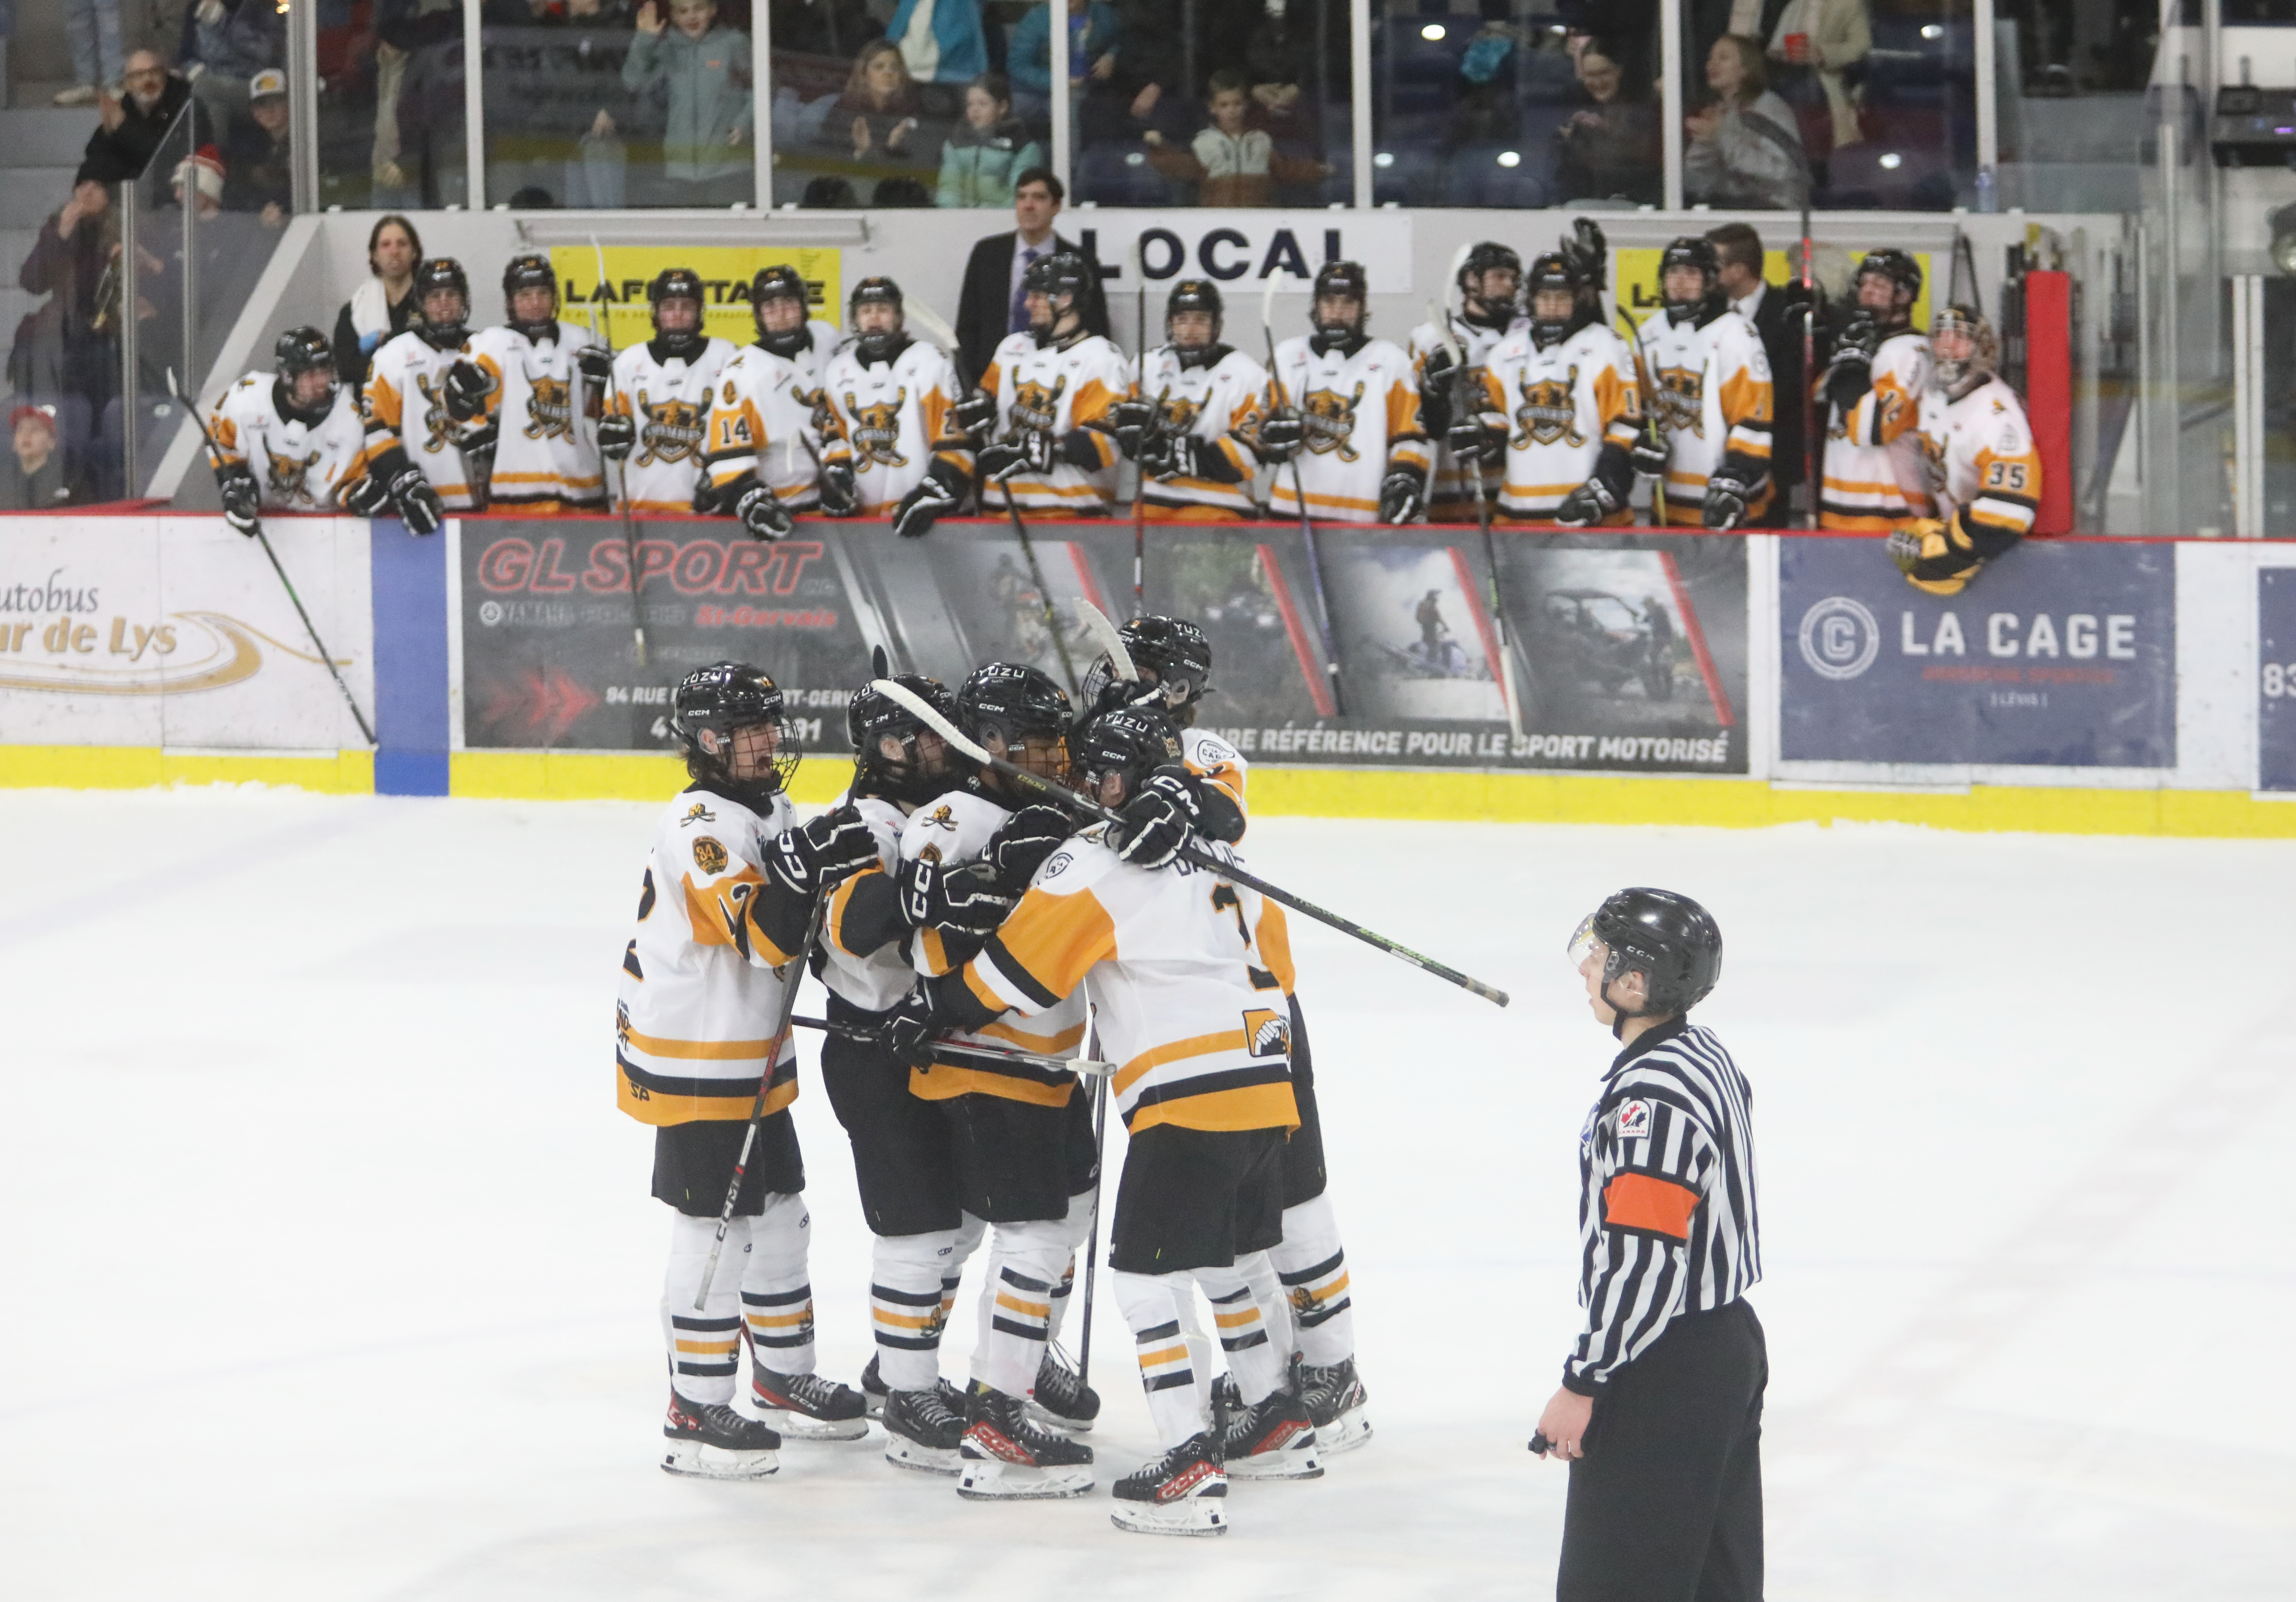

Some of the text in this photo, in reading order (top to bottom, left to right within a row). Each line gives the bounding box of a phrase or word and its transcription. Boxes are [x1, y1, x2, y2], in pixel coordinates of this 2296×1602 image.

[720, 416, 752, 445] 14
[1989, 461, 2025, 489] 35
[479, 538, 576, 592] GL
[583, 540, 823, 595] SPORT
[697, 606, 836, 626] St-Gervais
[43, 616, 98, 653] de
[109, 616, 177, 662] Lys
[1174, 623, 1204, 639] YUZ
[1902, 611, 1966, 657] LA
[1989, 612, 2137, 660] CAGE
[979, 666, 1025, 679] YUZU
[632, 686, 668, 704] RUE
[763, 694, 781, 704] CCM
[978, 703, 1005, 713] CCM
[1261, 721, 1402, 754] RÉFÉRENCE
[1406, 732, 1473, 756] POUR
[1477, 733, 1507, 757] LE
[1511, 735, 1598, 759] SPORT
[1598, 730, 1729, 762] MOTORISÉ
[1102, 750, 1126, 761] CCM
[715, 1181, 740, 1242] CCM
[789, 1392, 818, 1411] CCM
[1161, 1463, 1205, 1499] CCM
